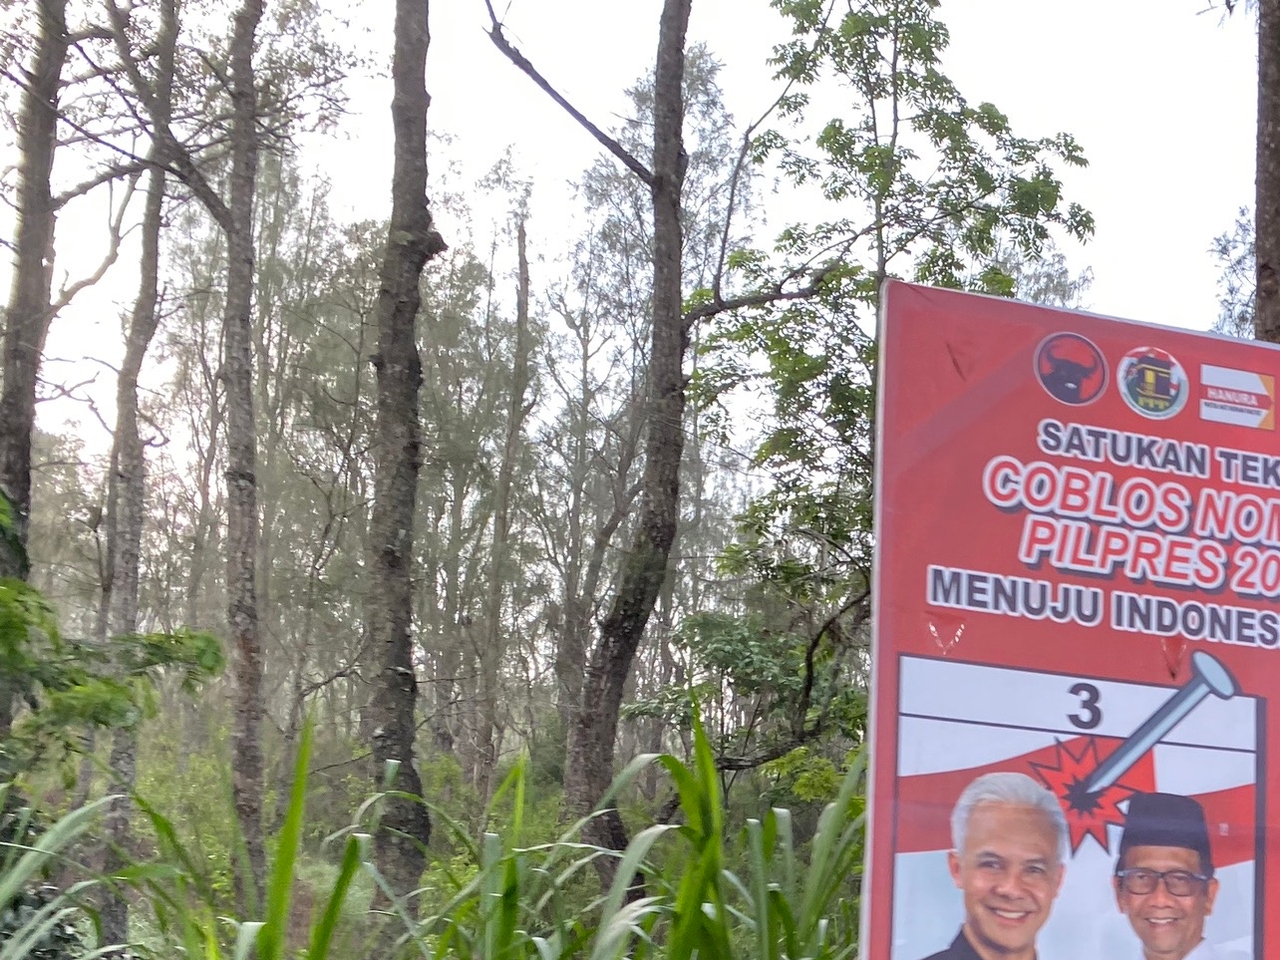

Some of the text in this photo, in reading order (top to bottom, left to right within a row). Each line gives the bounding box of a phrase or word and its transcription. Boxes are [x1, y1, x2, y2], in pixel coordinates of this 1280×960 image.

[1207, 387, 1259, 406] HANURA
[1038, 419, 1211, 478] SATUKAN
[984, 455, 1191, 532] COBLOS
[1020, 515, 1228, 592] PILPRES
[927, 565, 1102, 627] MENUJU
[1067, 683, 1103, 730] 3
